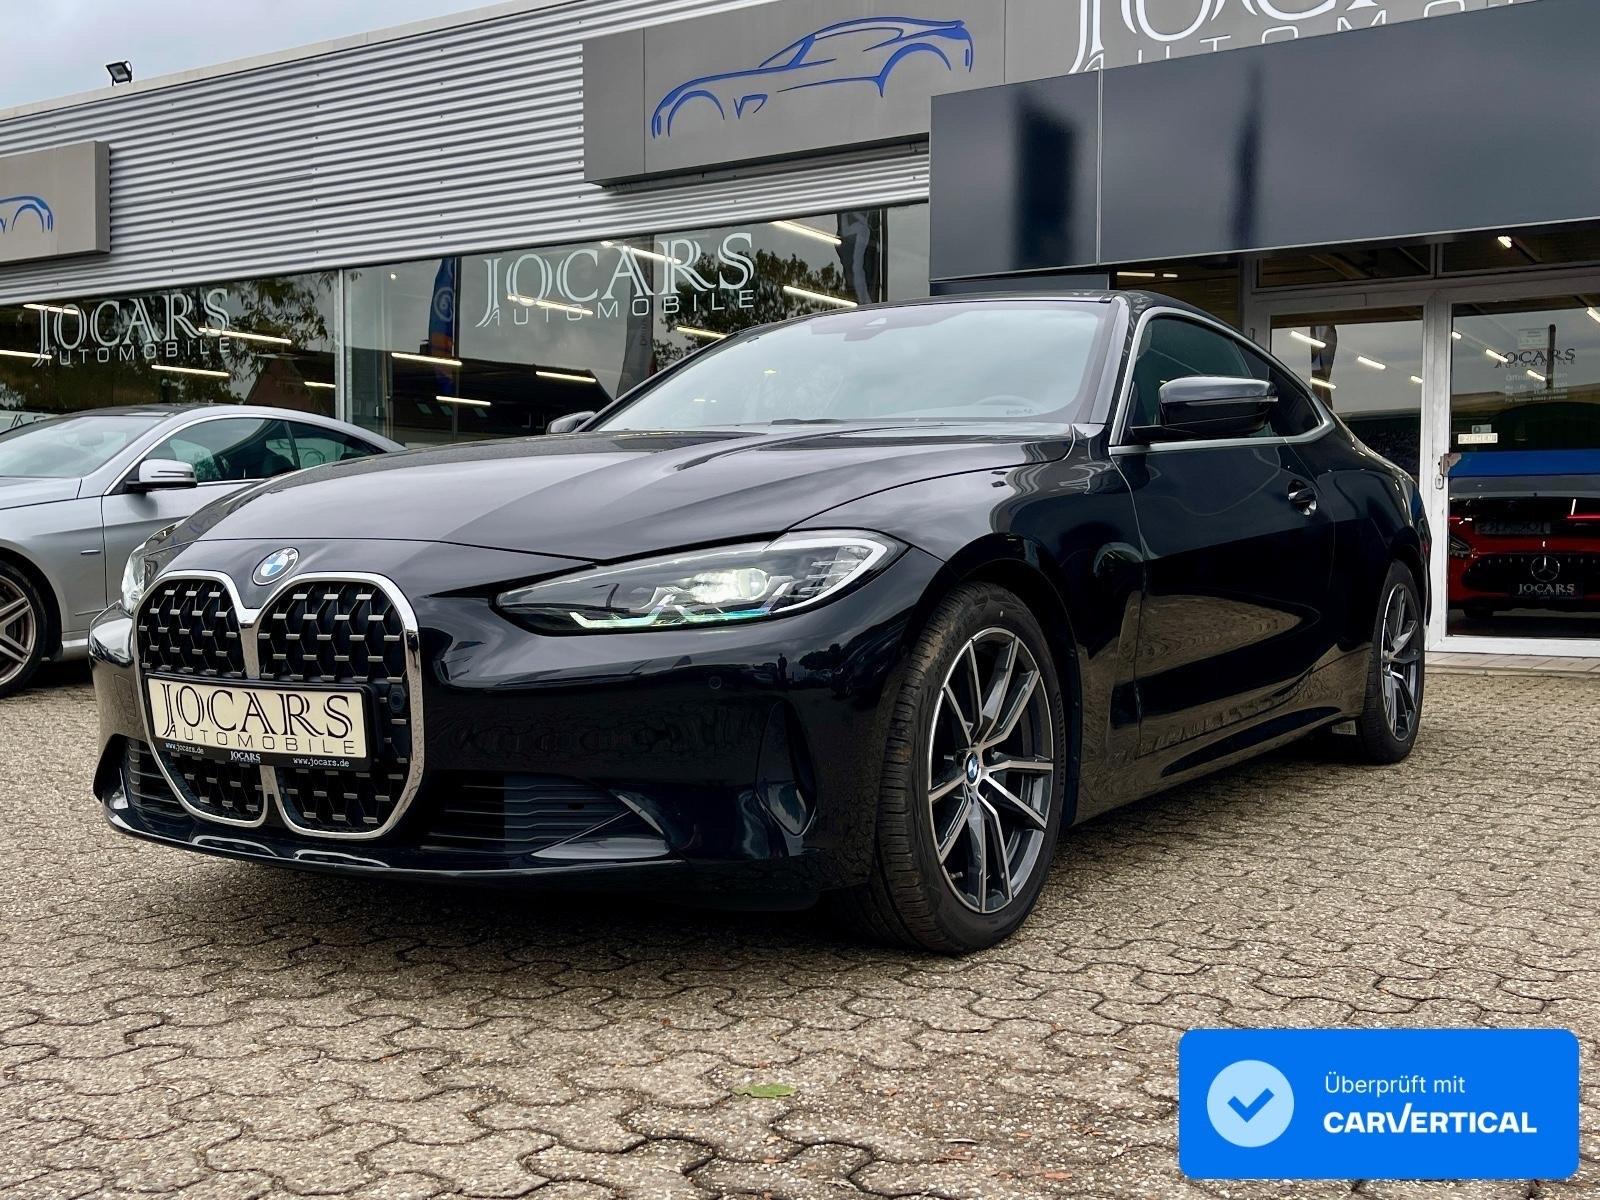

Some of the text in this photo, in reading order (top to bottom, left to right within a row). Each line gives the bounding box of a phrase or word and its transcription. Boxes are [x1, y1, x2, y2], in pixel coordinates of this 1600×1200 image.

[475, 232, 754, 328] JOCARS
[488, 289, 754, 326] AUTOMOBILE
[32, 288, 230, 367] JOCARS
[42, 337, 230, 366] AUTOMOBILE
[1517, 583, 1575, 595] JOCARS
[160, 683, 353, 739] JOCARS
[166, 724, 355, 755] AUTOMOBILE
[230, 750, 261, 762] JOCARS
[292, 757, 350, 768] www.jocars.de
